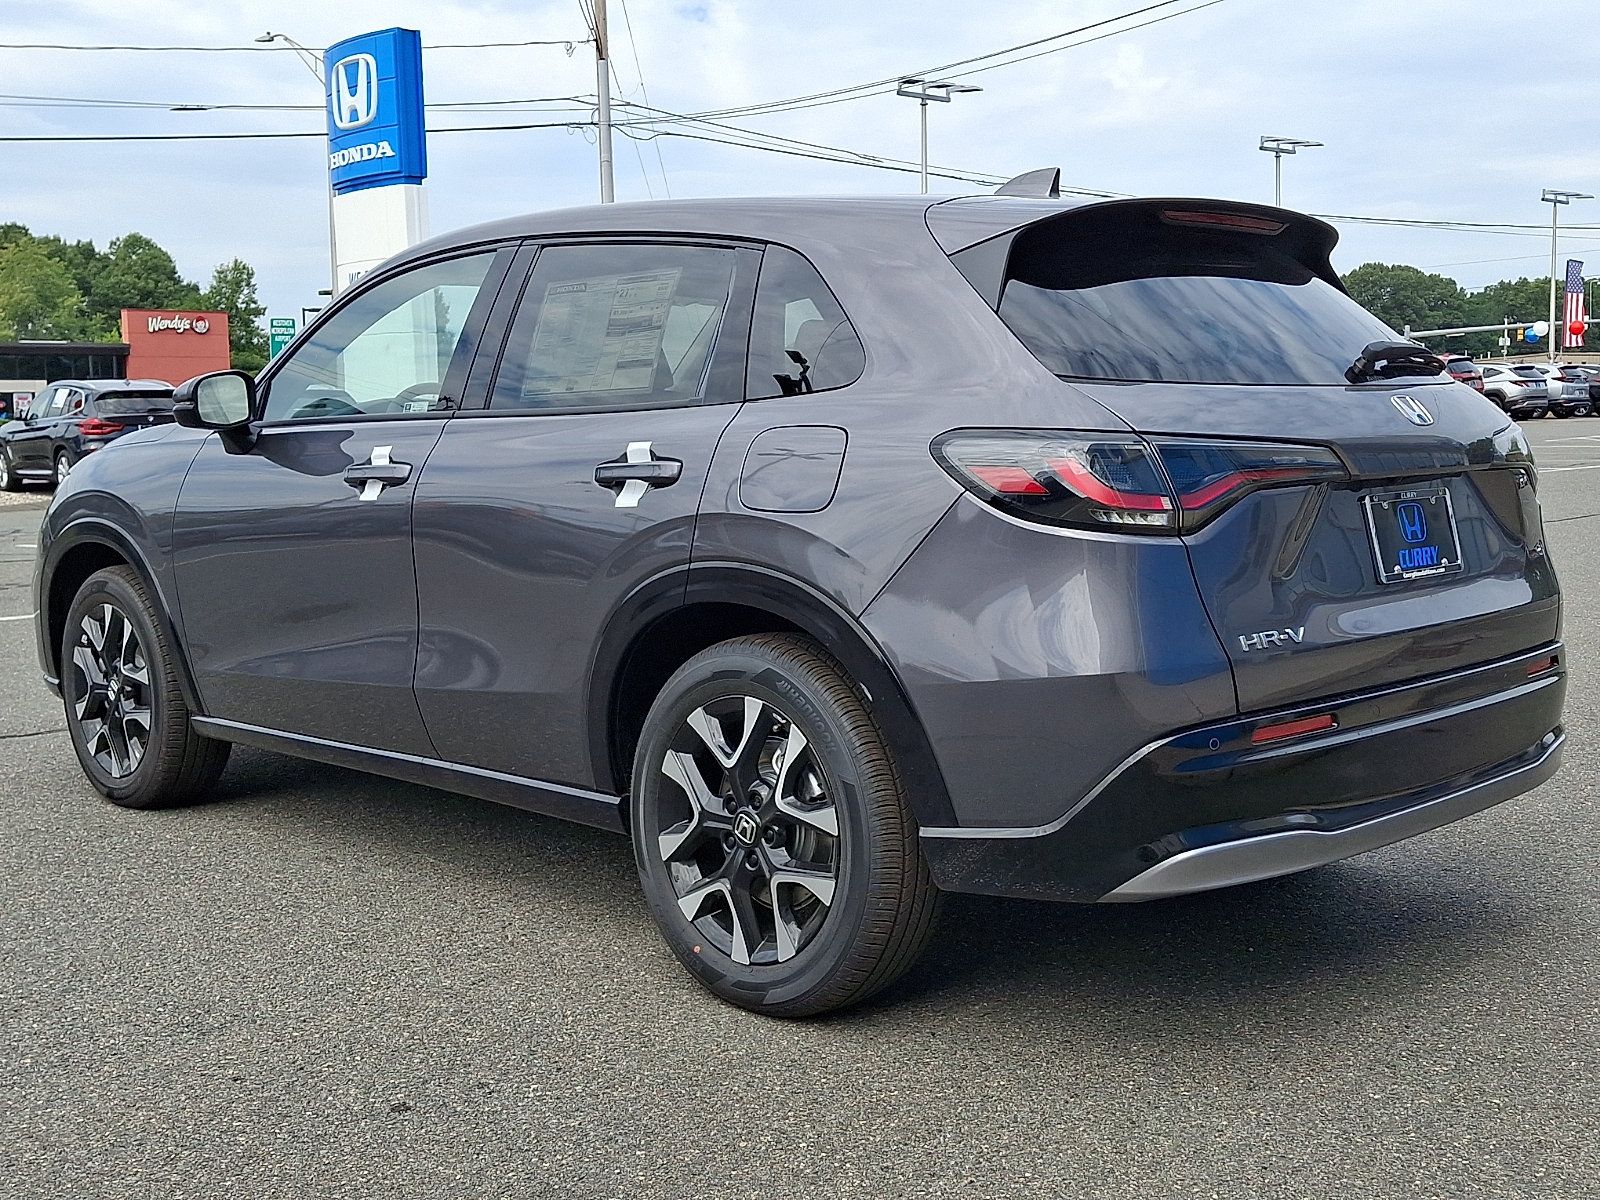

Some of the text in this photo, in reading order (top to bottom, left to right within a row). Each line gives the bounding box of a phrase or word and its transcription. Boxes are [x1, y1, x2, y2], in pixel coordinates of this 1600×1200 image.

[329, 140, 396, 170] HONDA
[148, 314, 191, 333] Wendy's
[1400, 491, 1417, 499] CURRY
[1399, 545, 1439, 569] CURRY
[1238, 626, 1305, 652] HR-V
